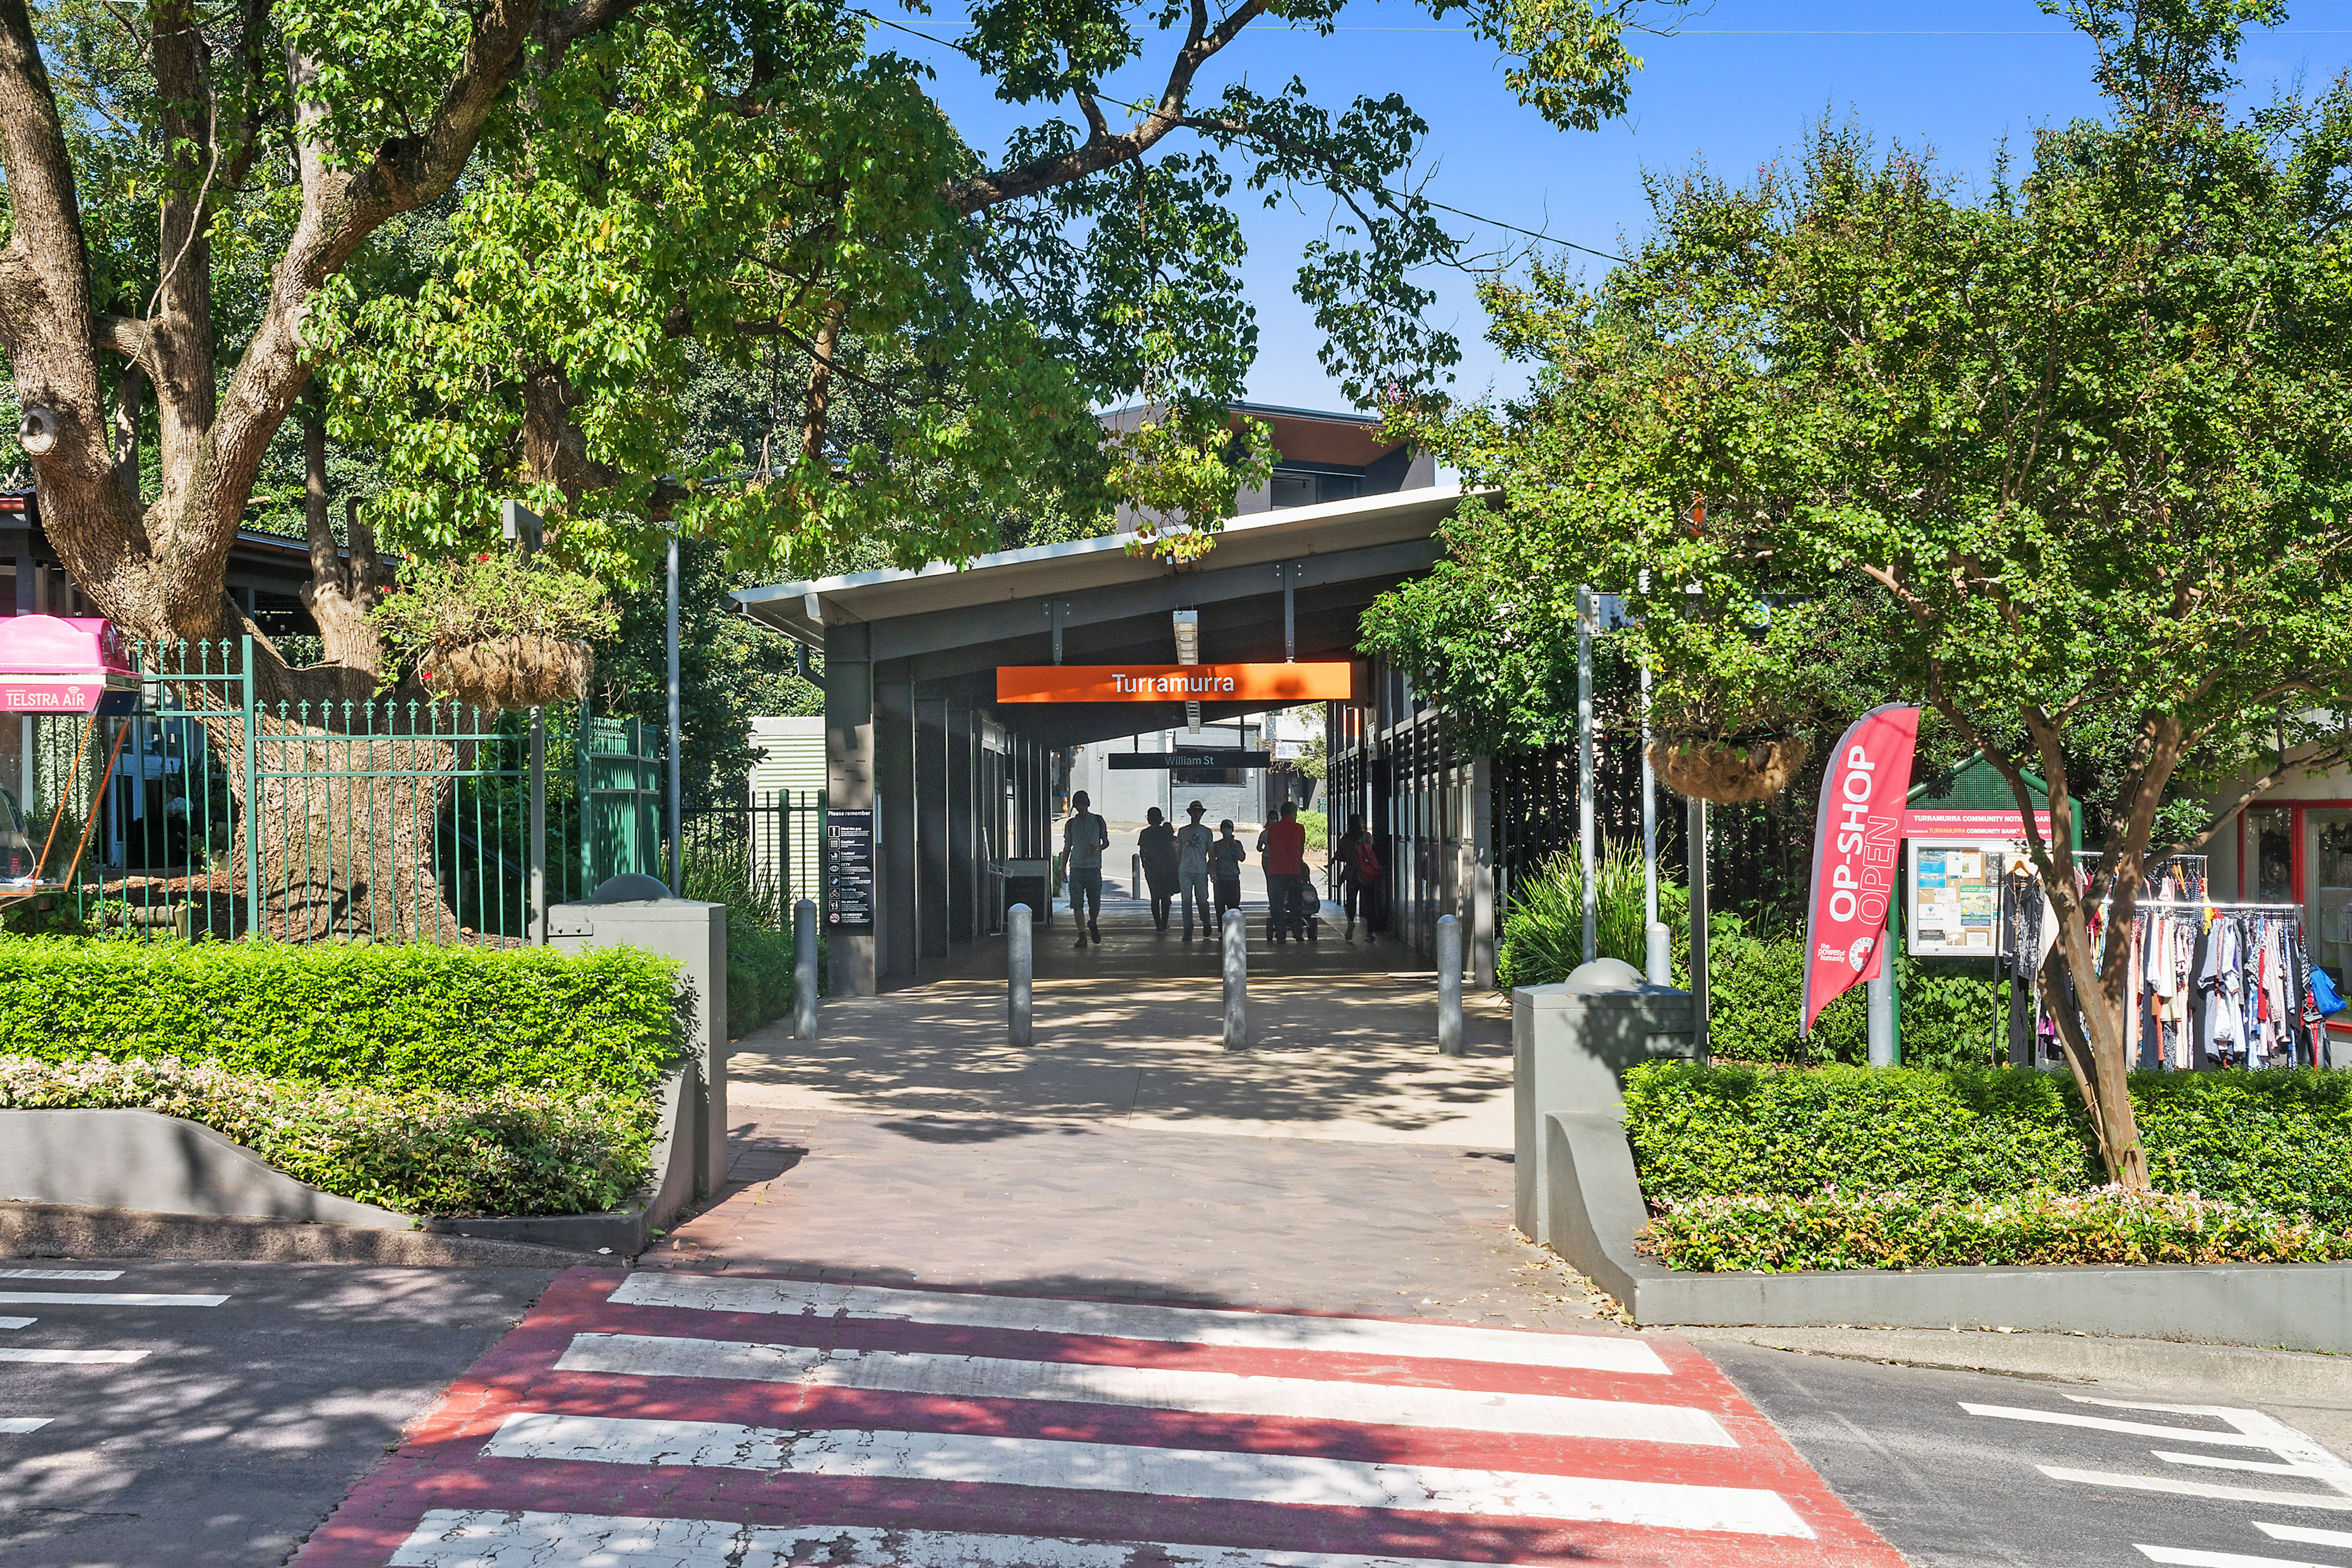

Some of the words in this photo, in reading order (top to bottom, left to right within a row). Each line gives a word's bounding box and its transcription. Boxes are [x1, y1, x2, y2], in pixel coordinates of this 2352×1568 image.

[1112, 674, 1234, 692] Turramurra
[6, 694, 59, 706] TELSTRA
[1165, 756, 1202, 765] William
[1203, 756, 1214, 765] St
[1829, 745, 1875, 922] OP-SHOP
[1857, 815, 1897, 925] OPEN
[1850, 956, 1859, 969] RED
